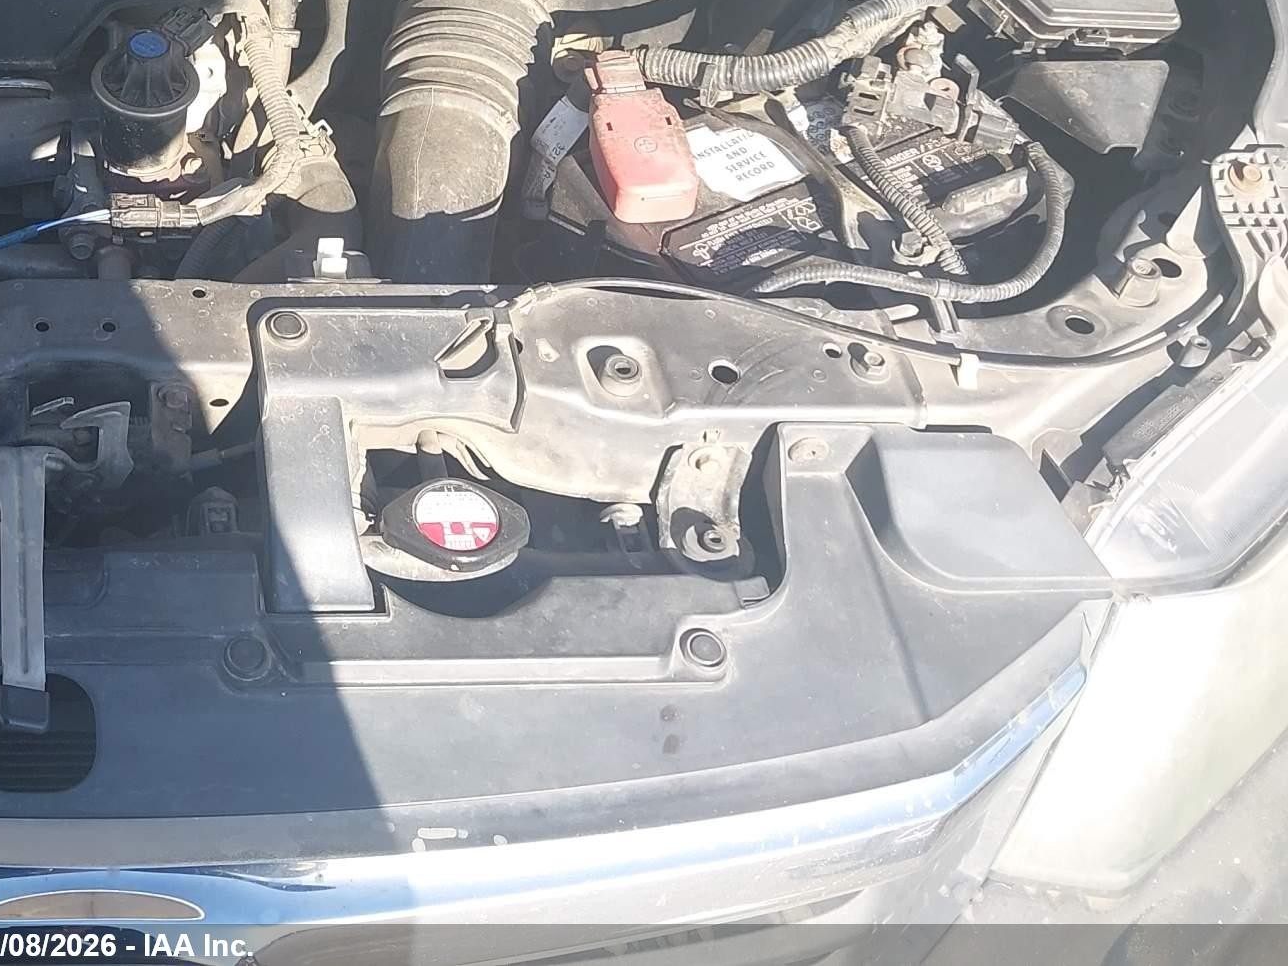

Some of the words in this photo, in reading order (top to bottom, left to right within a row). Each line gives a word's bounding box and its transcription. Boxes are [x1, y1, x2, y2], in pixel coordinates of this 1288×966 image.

[695, 130, 754, 161] INSTALLATIO
[725, 145, 749, 160] AND
[724, 149, 768, 174] SERVICE
[735, 160, 777, 183] RECORD
